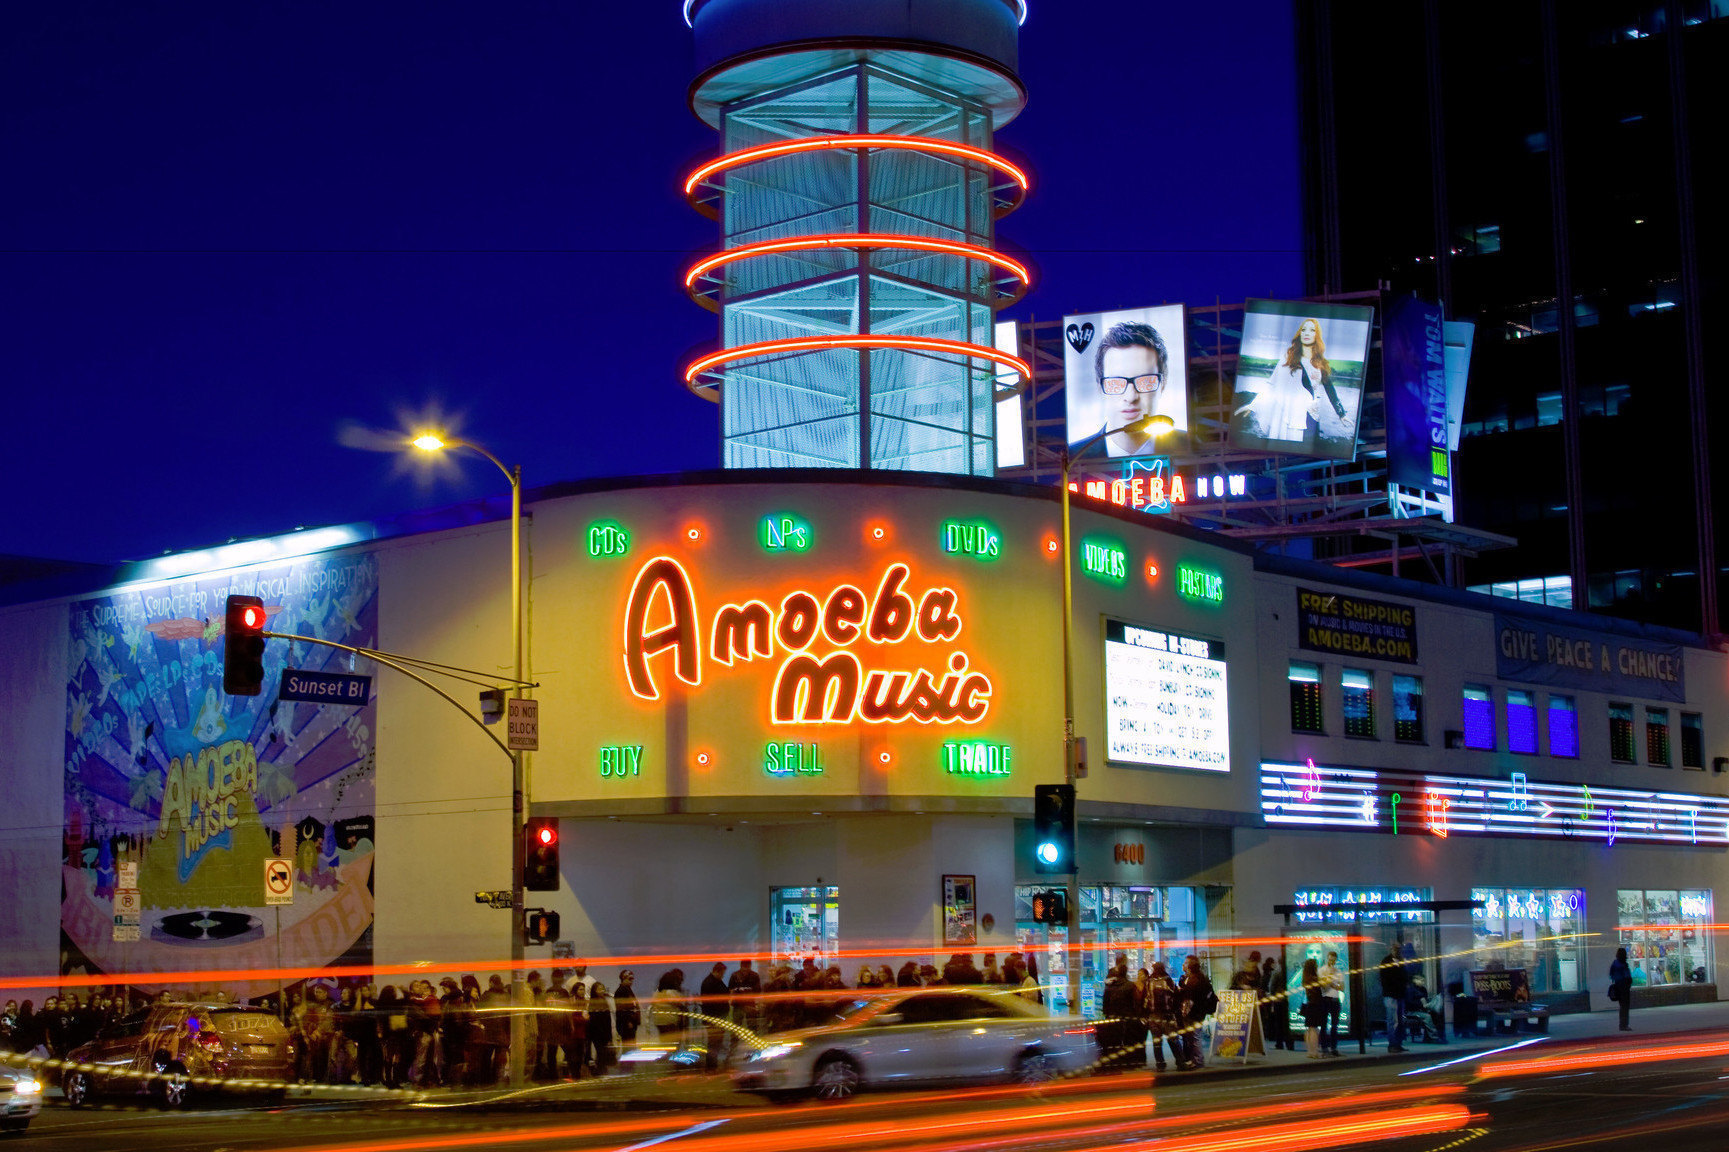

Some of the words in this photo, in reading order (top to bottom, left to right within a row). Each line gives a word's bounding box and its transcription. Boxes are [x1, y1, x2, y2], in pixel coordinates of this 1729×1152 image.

[1424, 313, 1443, 364] TOM
[1427, 369, 1448, 445] WAITS
[1196, 475, 1246, 498] NOW
[589, 525, 629, 556] CDs
[945, 523, 998, 557] DVDs
[1084, 543, 1125, 578] VIDEOS
[92, 602, 139, 627] SUPREME
[145, 595, 186, 618] SOURCE
[243, 576, 293, 601] MUSICAL
[296, 563, 373, 595] INSPIRATION
[1179, 567, 1223, 601] POSTERS
[1301, 593, 1339, 615] FREE
[1343, 599, 1412, 626] SHIPPING
[623, 556, 963, 700] Amoeba
[1308, 627, 1412, 658] AMOEBA.COM
[1349, 621, 1374, 634] MOVIES
[1500, 628, 1539, 661] GIVE
[1546, 634, 1594, 670] PEACE
[1601, 644, 1612, 672] A
[1618, 647, 1681, 682] CHANCE!
[288, 677, 344, 696] Sunset
[348, 681, 364, 698] Bl
[771, 650, 993, 724] Music
[509, 705, 520, 717] DO
[522, 706, 537, 719] NOT
[509, 721, 537, 735] BLOCK
[599, 744, 643, 777] BUY
[765, 741, 824, 774] SELL
[943, 743, 1012, 776] TRADE
[159, 740, 258, 840] AMOEBA
[185, 794, 239, 859] MUSIC
[1114, 842, 1145, 866] 6400
